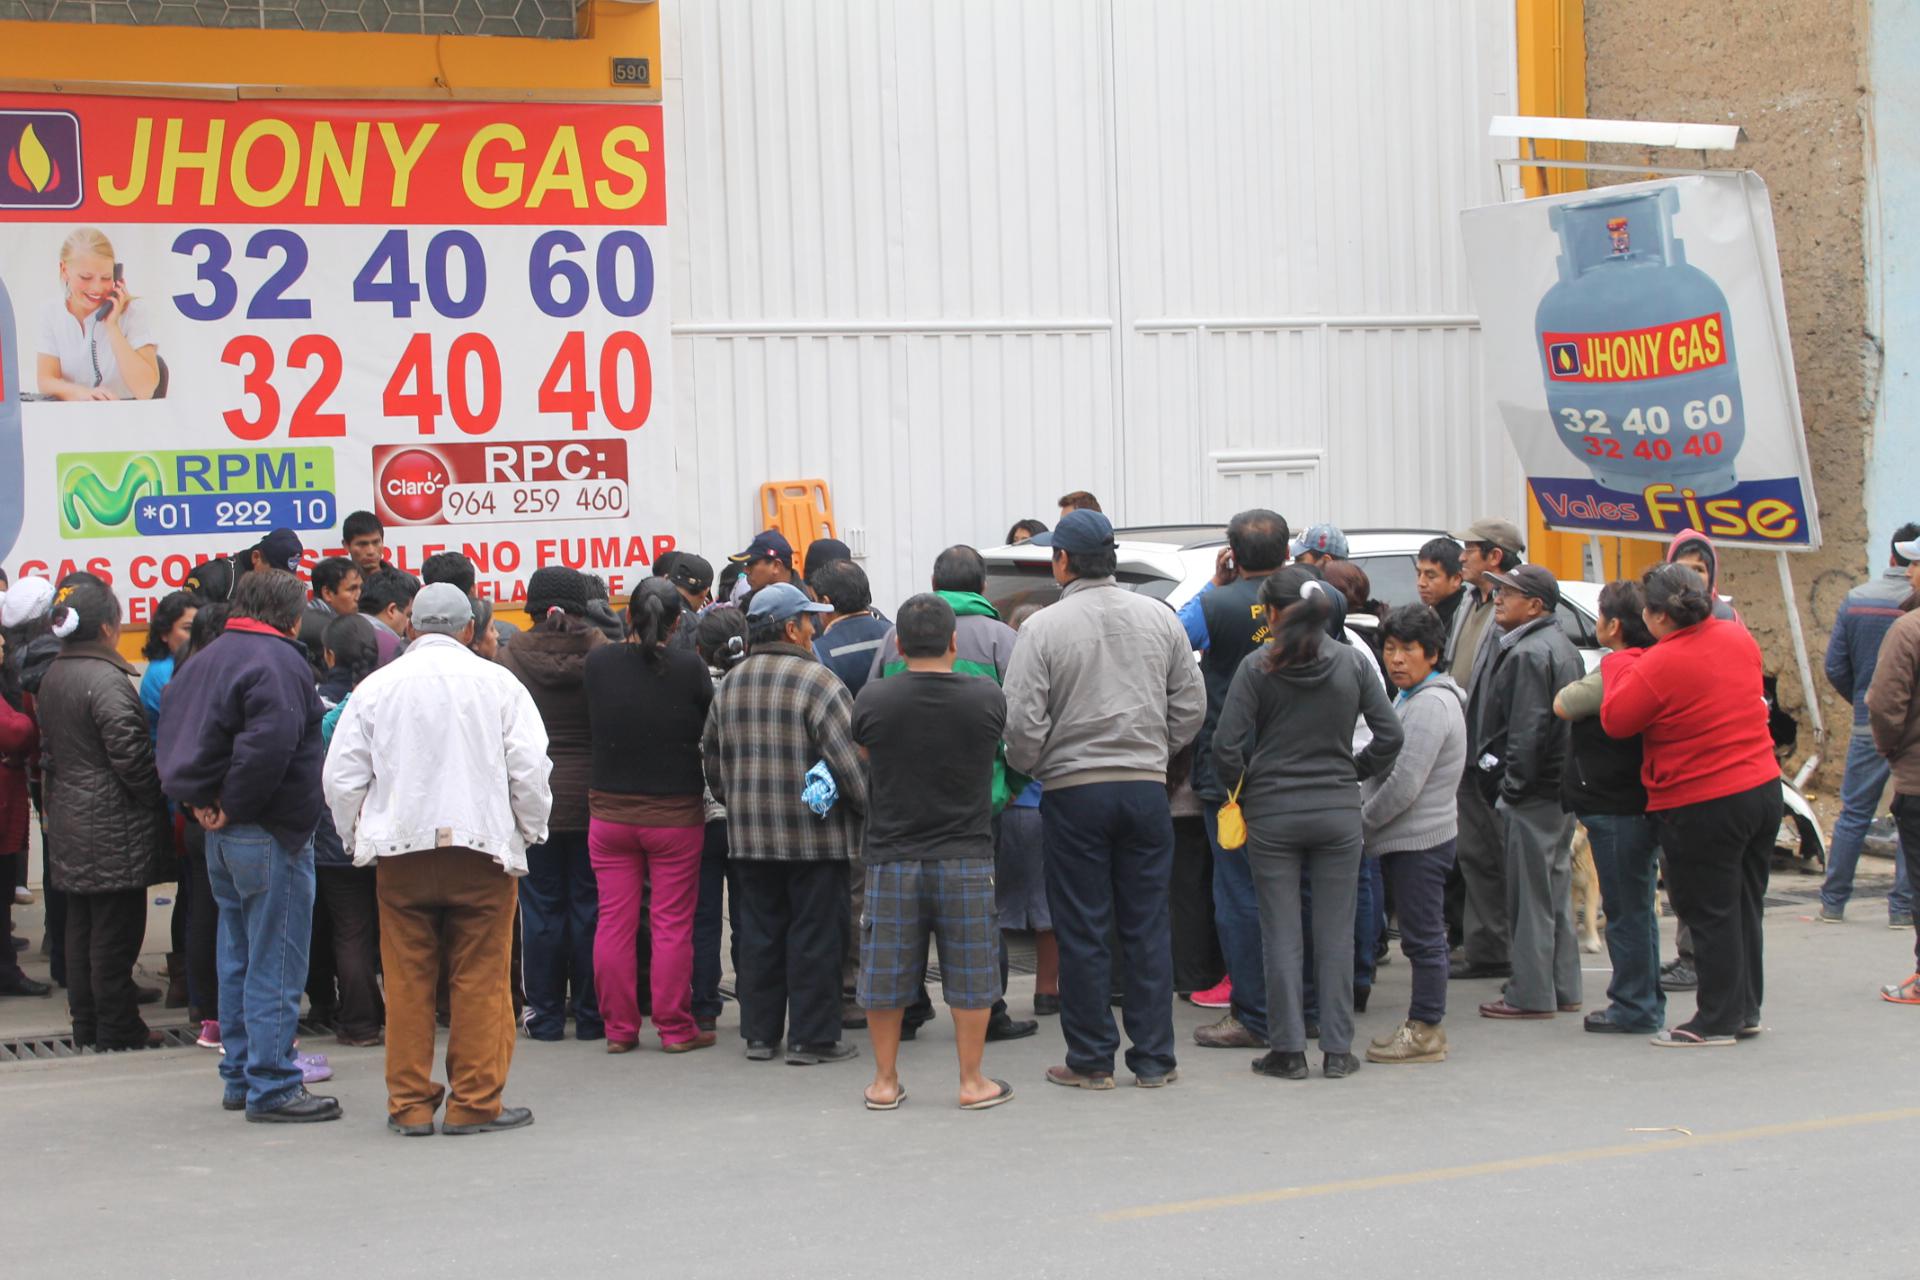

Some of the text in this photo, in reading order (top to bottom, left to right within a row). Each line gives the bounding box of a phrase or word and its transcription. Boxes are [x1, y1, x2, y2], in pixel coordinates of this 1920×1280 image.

[616, 64, 647, 80] 590
[98, 117, 650, 211] JHONY GAS
[171, 229, 654, 321] 32 40 60
[1583, 318, 1721, 378] JHONY GAS
[221, 331, 652, 441] 32 40 40
[1560, 394, 1732, 435] 32 40 60
[484, 443, 606, 482] RPC:
[1583, 431, 1723, 462] 32 40 40
[176, 452, 315, 493] RPM:
[387, 475, 439, 496] Claro
[216, 500, 272, 527] 222
[293, 499, 327, 524] 10
[449, 486, 622, 516] 964 259 460
[1543, 492, 1640, 521] Vales
[462, 540, 521, 574] NO
